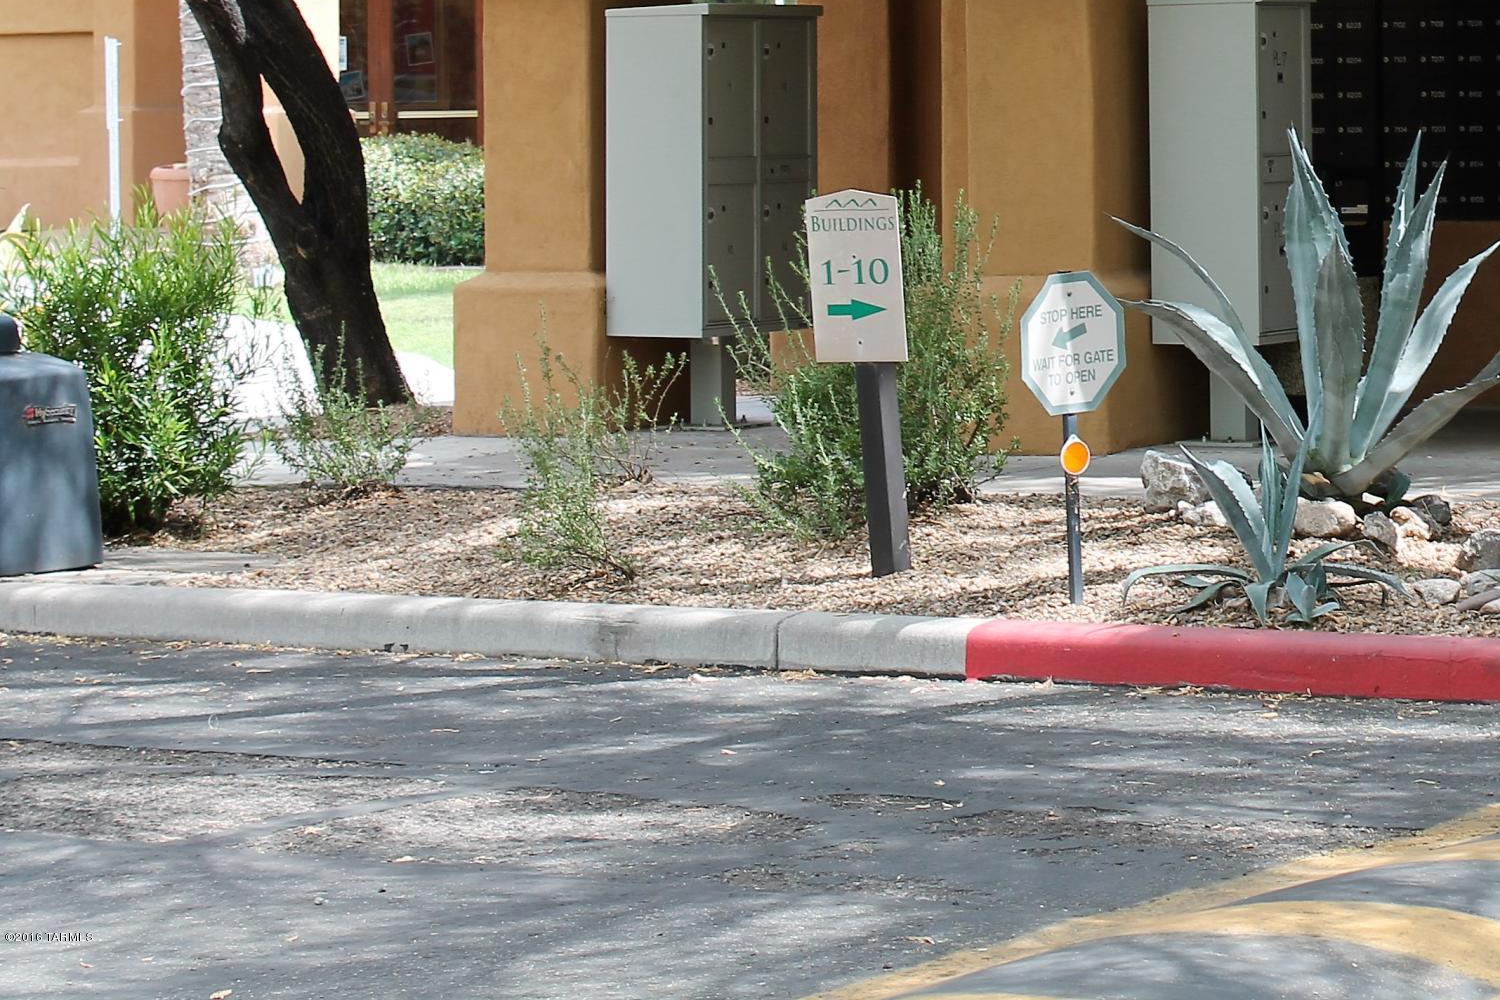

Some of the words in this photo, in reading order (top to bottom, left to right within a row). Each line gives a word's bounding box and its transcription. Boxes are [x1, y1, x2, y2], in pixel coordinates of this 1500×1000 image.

[811, 215, 896, 234] BUILDINGS
[820, 257, 890, 286] 1-10
[1040, 308, 1067, 325] STOP
[1070, 304, 1102, 320] HERE
[1032, 356, 1056, 372] WAIT
[1058, 352, 1081, 367] FOR
[1083, 349, 1114, 365] GATE
[1048, 373, 1062, 387] TO
[1065, 368, 1097, 385] OPEN
